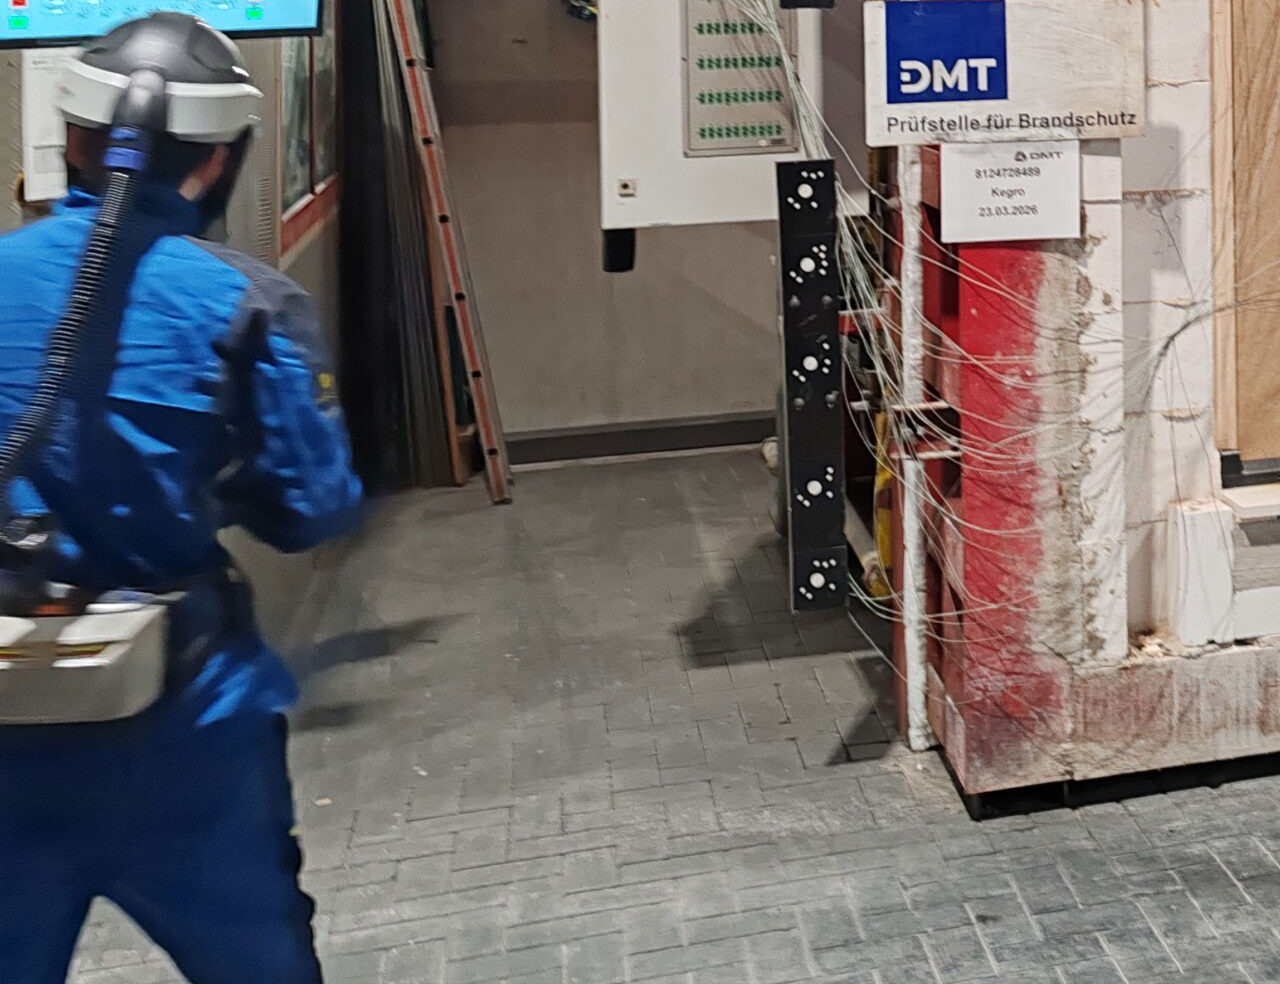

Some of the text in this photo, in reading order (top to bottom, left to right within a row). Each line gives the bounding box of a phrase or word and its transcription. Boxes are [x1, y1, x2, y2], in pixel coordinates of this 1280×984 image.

[899, 57, 997, 94] DMT
[886, 110, 1137, 133] Prüfstelle für Brandschutz
[1030, 150, 1063, 160] DMT
[991, 186, 1026, 200] Kegro
[978, 204, 1039, 218] 23.03.2026
